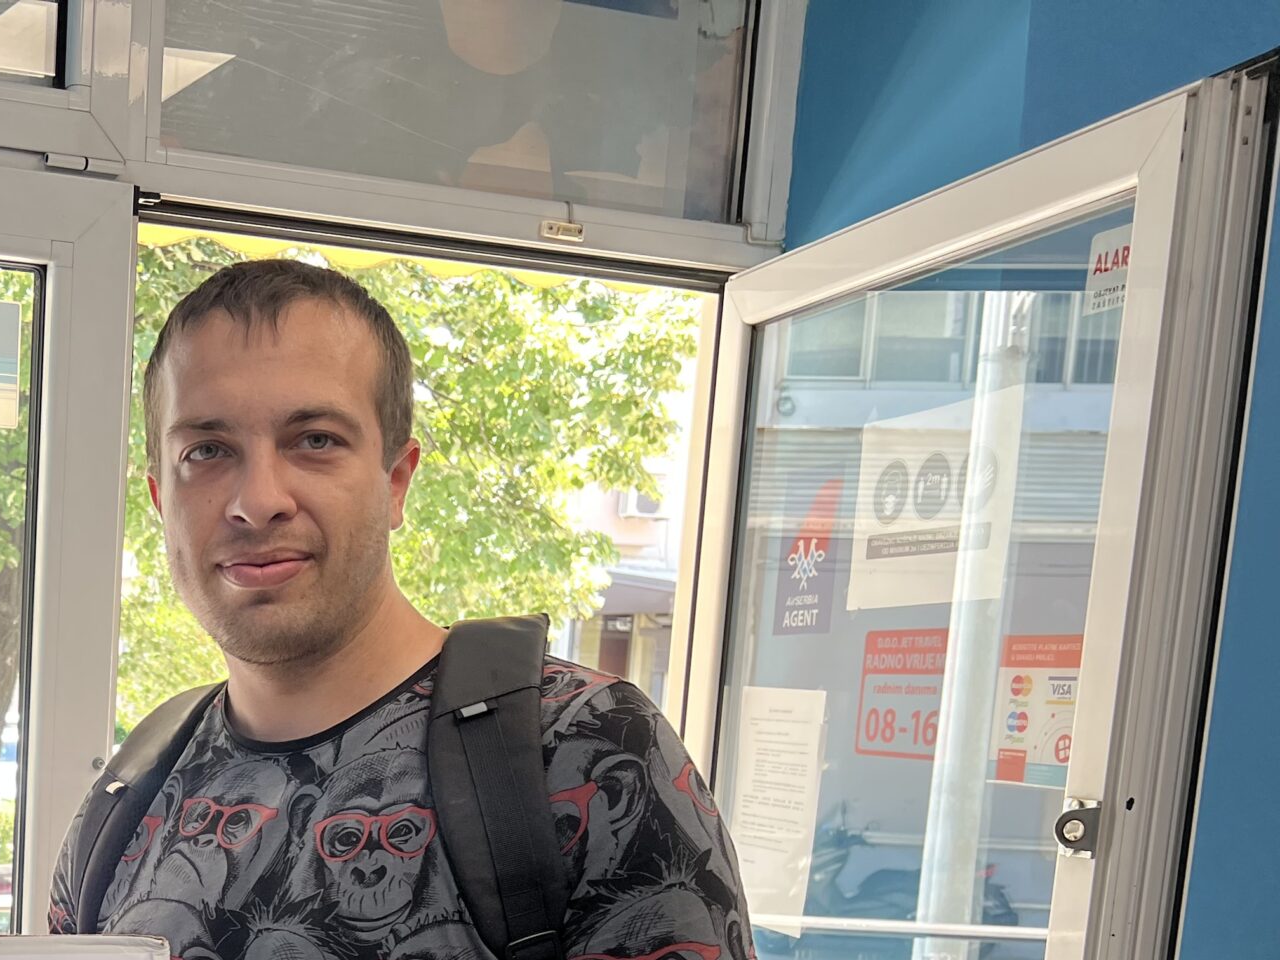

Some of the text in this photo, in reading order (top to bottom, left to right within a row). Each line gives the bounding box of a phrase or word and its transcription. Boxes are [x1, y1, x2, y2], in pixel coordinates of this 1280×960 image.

[1093, 245, 1130, 275] ALAR
[782, 609, 818, 628] AGENT
[866, 653, 904, 670] RADNO
[1051, 683, 1072, 696] VISA
